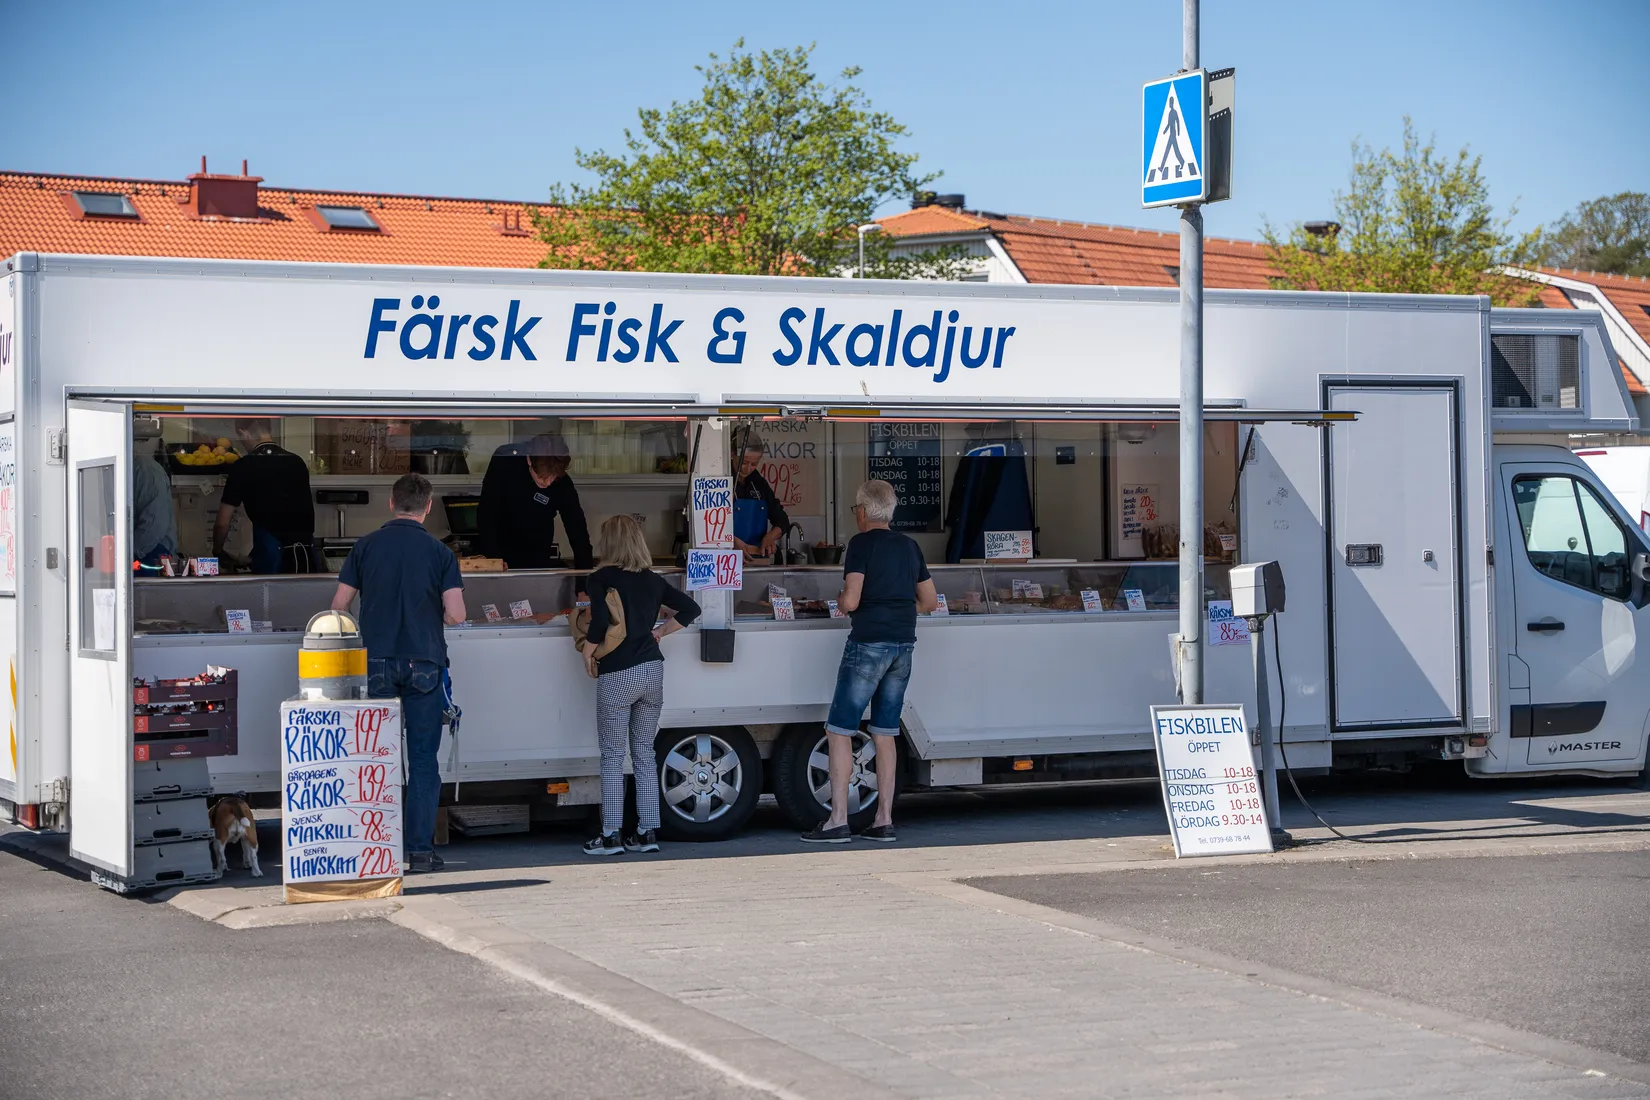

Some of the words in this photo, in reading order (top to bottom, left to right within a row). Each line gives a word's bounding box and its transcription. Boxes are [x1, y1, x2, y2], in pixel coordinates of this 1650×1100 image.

[364, 295, 543, 361] Färsk
[566, 301, 685, 363] Fisk
[707, 307, 747, 364] &
[772, 306, 1017, 383] Skaldjur
[870, 423, 939, 437] FISKBILEN
[762, 438, 816, 459] ÄKOR
[889, 438, 919, 450] ÖPPET
[869, 457, 904, 467] TISDAG
[917, 457, 940, 467] 10-18
[869, 471, 908, 480] ONSDAG
[917, 470, 940, 479] 10-18
[694, 478, 729, 490] FÄRSKA
[918, 483, 940, 492] 10-18
[693, 489, 731, 510] RÄKOR
[910, 496, 940, 505] 9.30-14
[704, 507, 727, 542] 199
[987, 532, 1017, 542] SKAGEN-
[688, 562, 716, 579] RÄKOR
[1210, 606, 1233, 619] RÄKSM
[289, 708, 341, 725] FÄRSKA
[355, 708, 382, 753] 199
[1158, 717, 1244, 735] FISKBILEN
[285, 726, 349, 764] RÄKOR
[1188, 740, 1221, 753] ÖPPET
[1560, 741, 1621, 752] MASTER
[288, 768, 337, 782] GÅRDAGENS
[1165, 768, 1207, 780] TISDAG
[1223, 766, 1254, 779] 10-18
[286, 779, 347, 812] RÄKOR
[1168, 783, 1215, 797] ONSDAG
[1227, 782, 1257, 795] 10-18
[1171, 800, 1215, 812] FREDAG
[1230, 798, 1260, 810] 10-18
[291, 814, 323, 826] SVENSK
[1175, 815, 1221, 829] LÖRDAG
[1222, 813, 1263, 826] 9.30-14
[287, 824, 359, 847] MAKRILL
[1209, 835, 1234, 844] 0739-68
[303, 847, 328, 857] BENFRI
[290, 855, 360, 879] HAVSKATT
